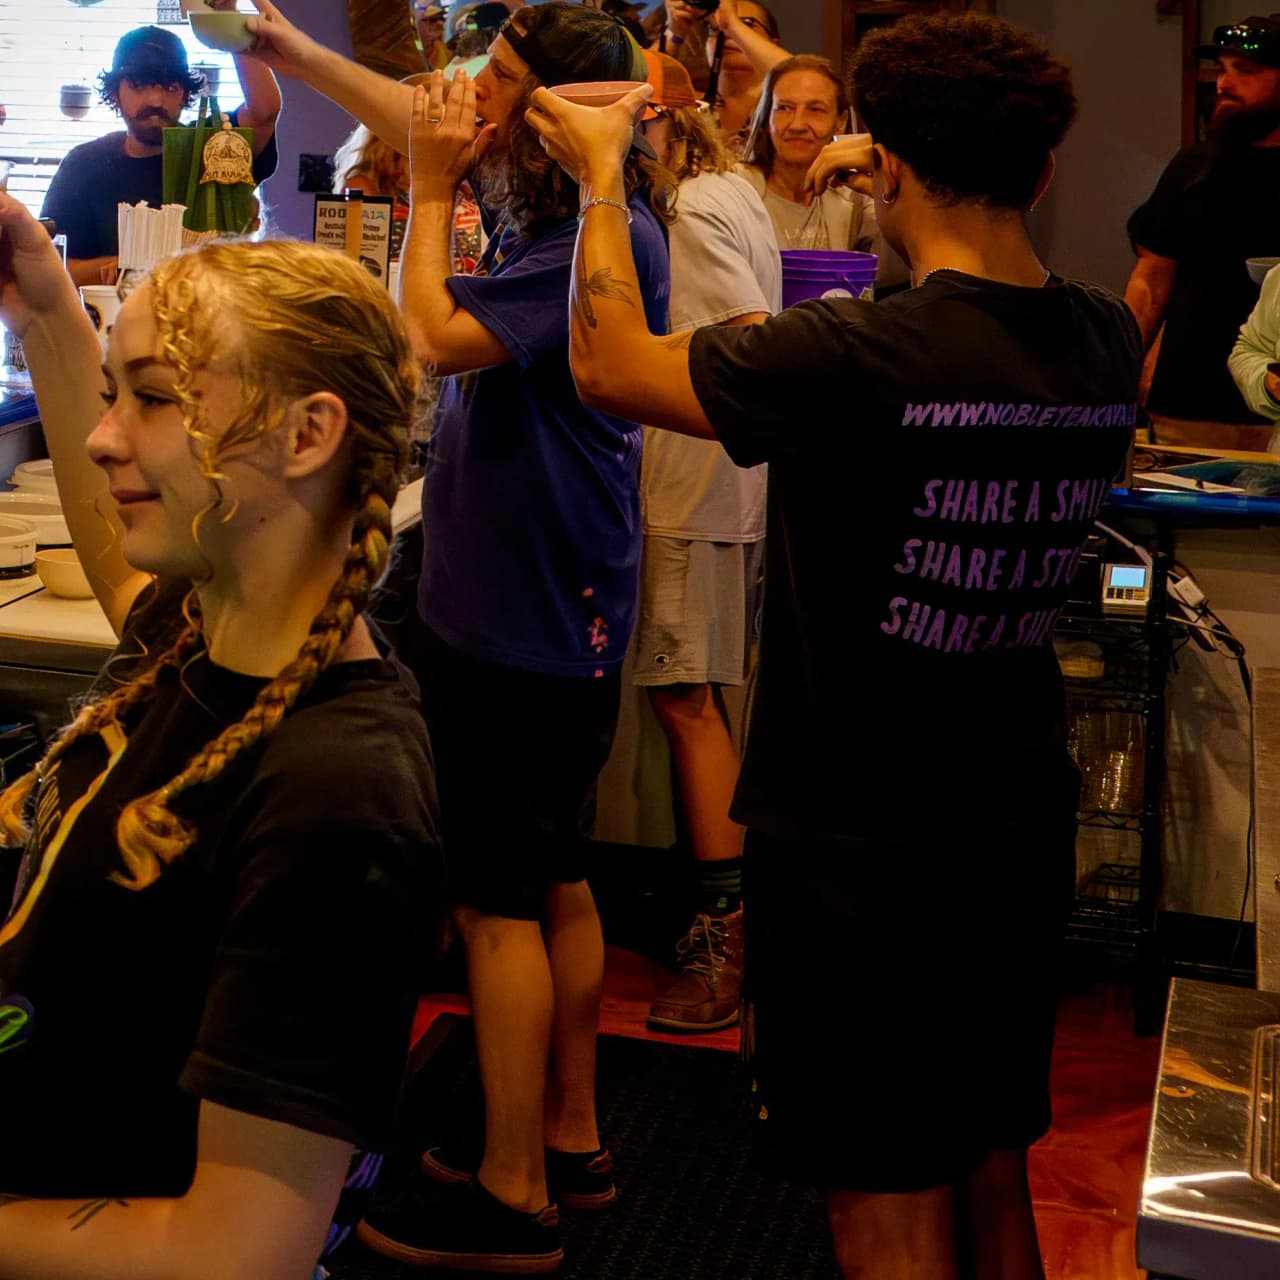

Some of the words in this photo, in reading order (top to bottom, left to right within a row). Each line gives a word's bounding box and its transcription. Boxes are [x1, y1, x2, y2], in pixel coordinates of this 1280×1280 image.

[912, 478, 1019, 524] SHARE
[1024, 479, 1041, 523] A
[893, 537, 1007, 591] SHARE
[1008, 547, 1028, 590] A
[879, 595, 988, 655] SHARE
[985, 613, 1006, 649] A
